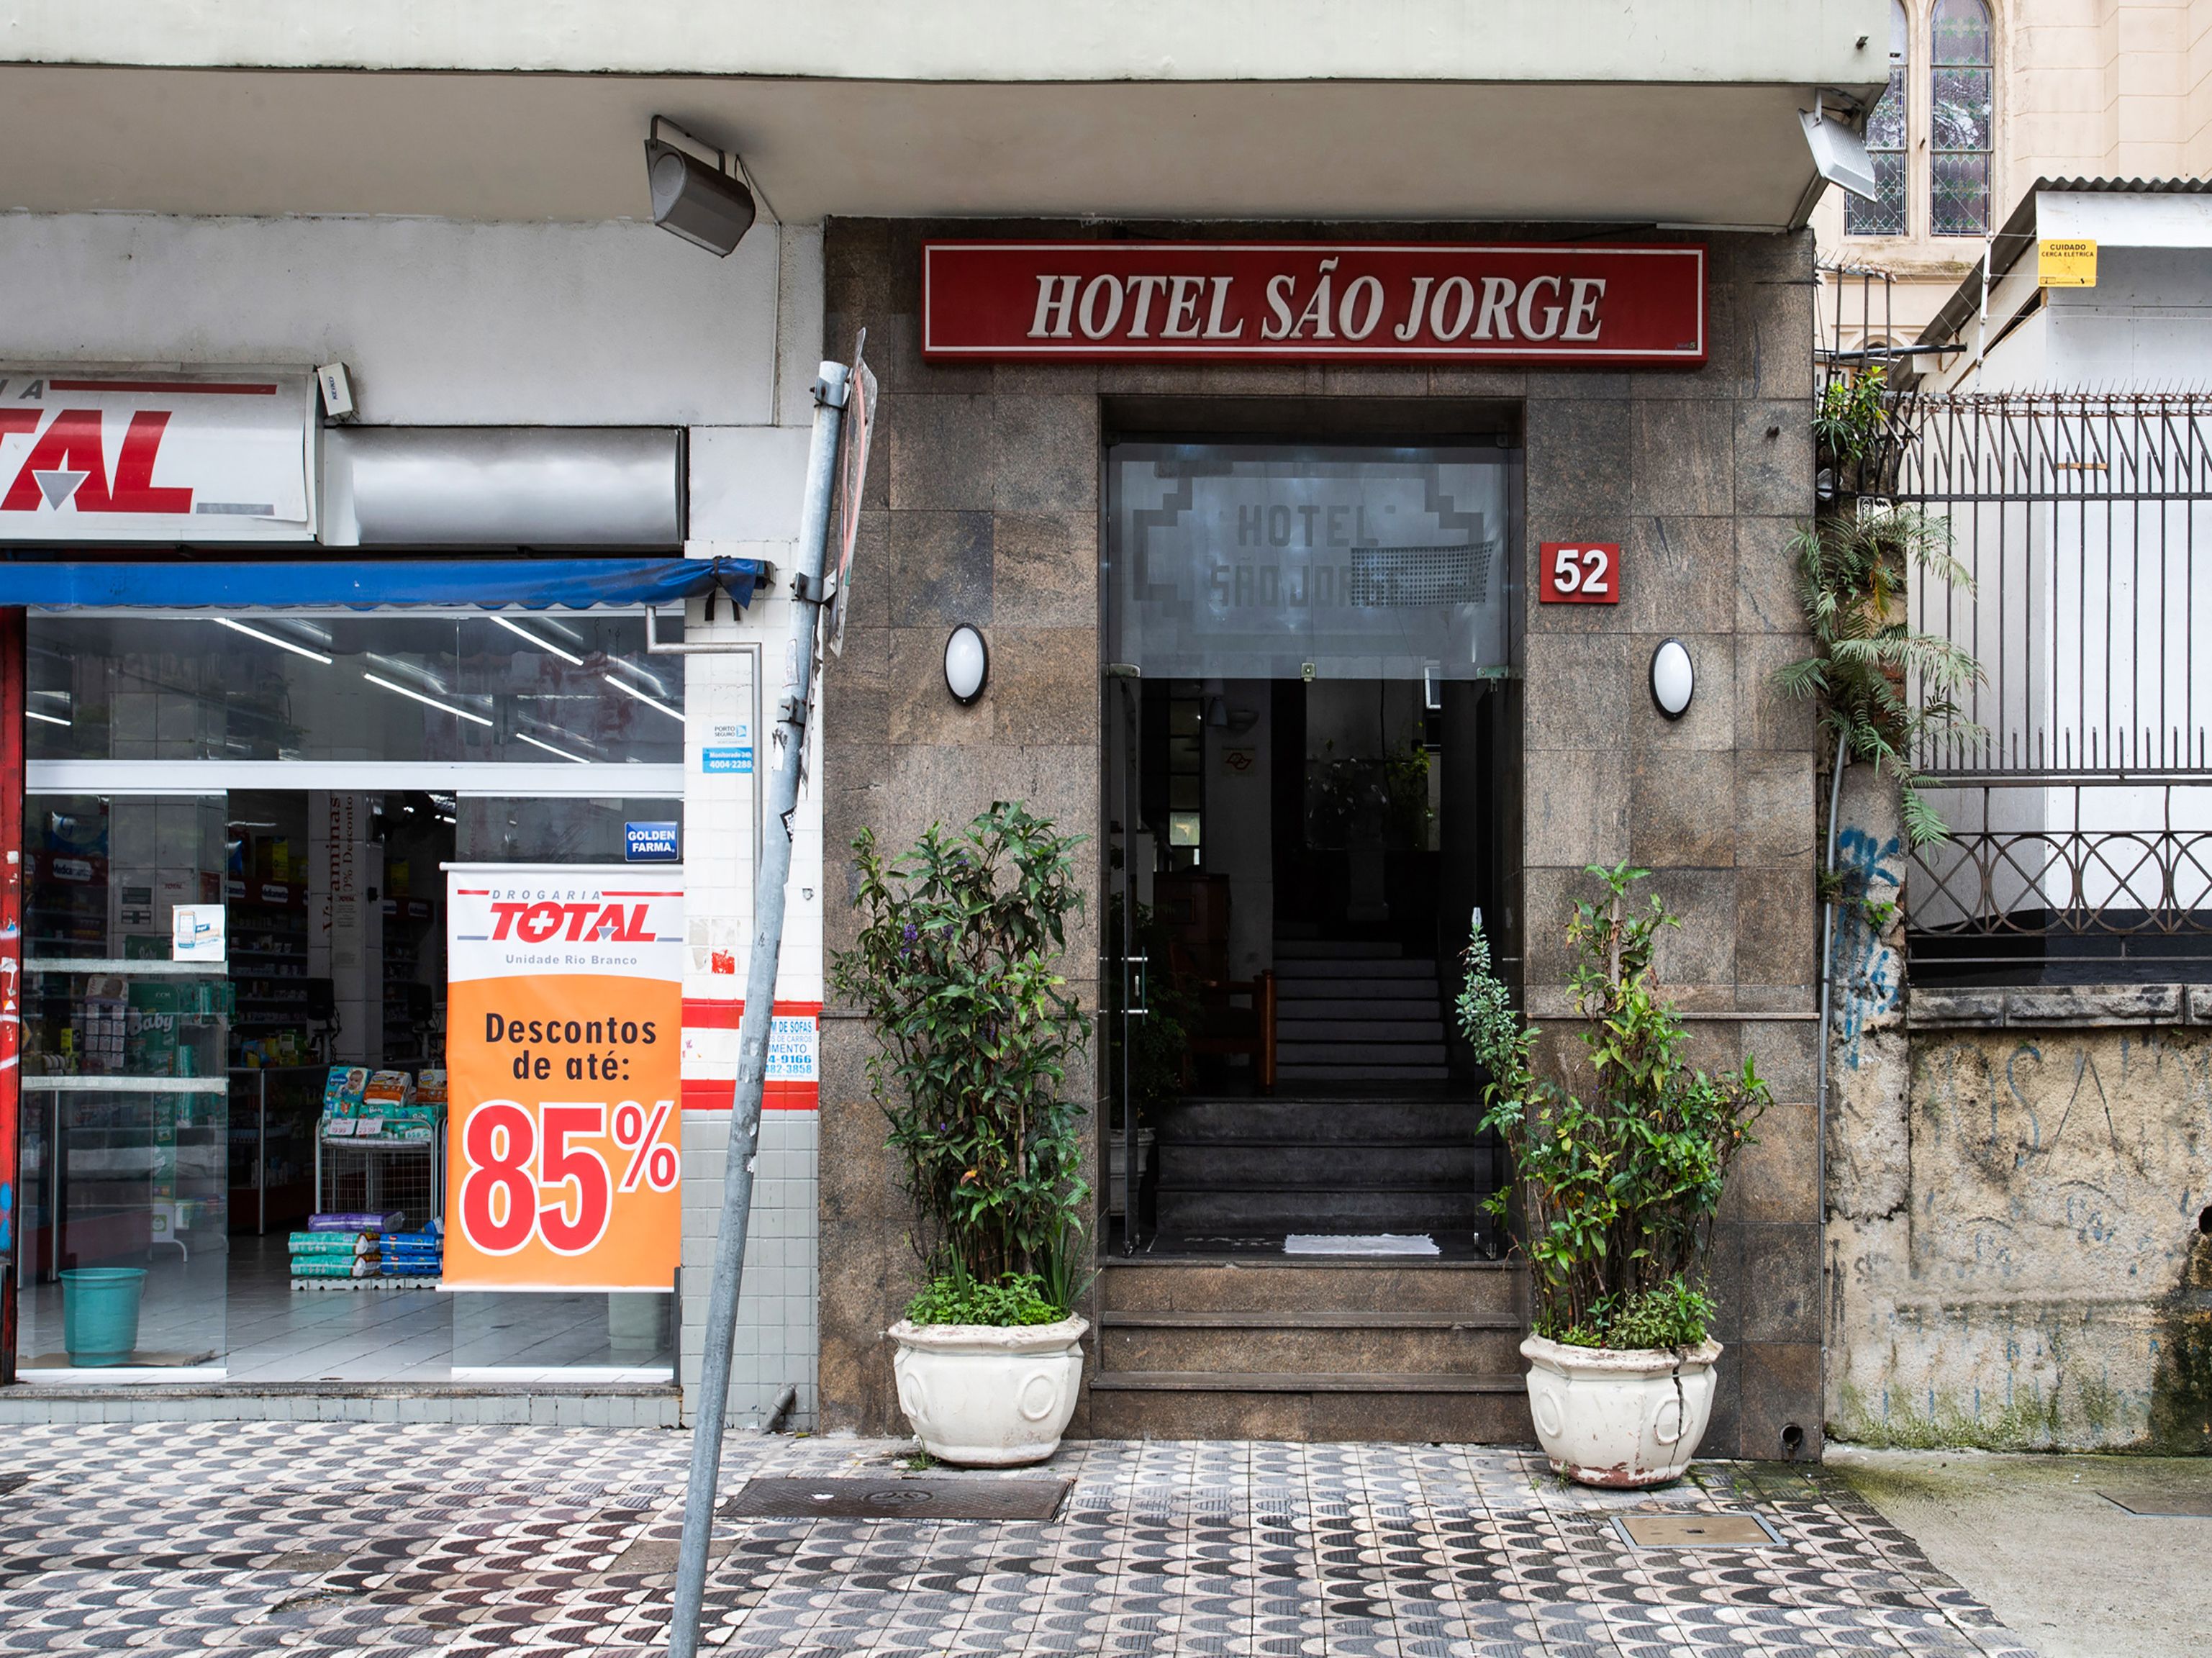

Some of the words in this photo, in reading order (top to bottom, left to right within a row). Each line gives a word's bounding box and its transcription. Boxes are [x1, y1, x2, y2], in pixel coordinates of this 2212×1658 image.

[1027, 274, 1245, 340] HOTEL
[1261, 256, 1385, 342] SÃO
[1394, 276, 1607, 342] JORGE
[328, 376, 338, 400] KEIKO
[1239, 505, 1379, 547] HOTEL
[1554, 549, 1608, 592] 52
[710, 760, 752, 769] 4004-2288
[343, 796, 353, 864] Desconto
[628, 830, 675, 841] GOLDEN
[492, 889, 601, 900] DROGARIA
[490, 901, 656, 943] TOTAL
[506, 953, 560, 965] Unidade
[565, 954, 586, 965] Rio
[591, 954, 638, 965] Branco
[486, 1013, 657, 1044] Descontos
[779, 1021, 788, 1033] DE
[790, 1020, 812, 1033] SOFAS
[769, 1043, 807, 1053] IMENTO
[513, 1050, 551, 1080] de
[566, 1051, 630, 1080] até:
[458, 1099, 681, 1256] 85%
